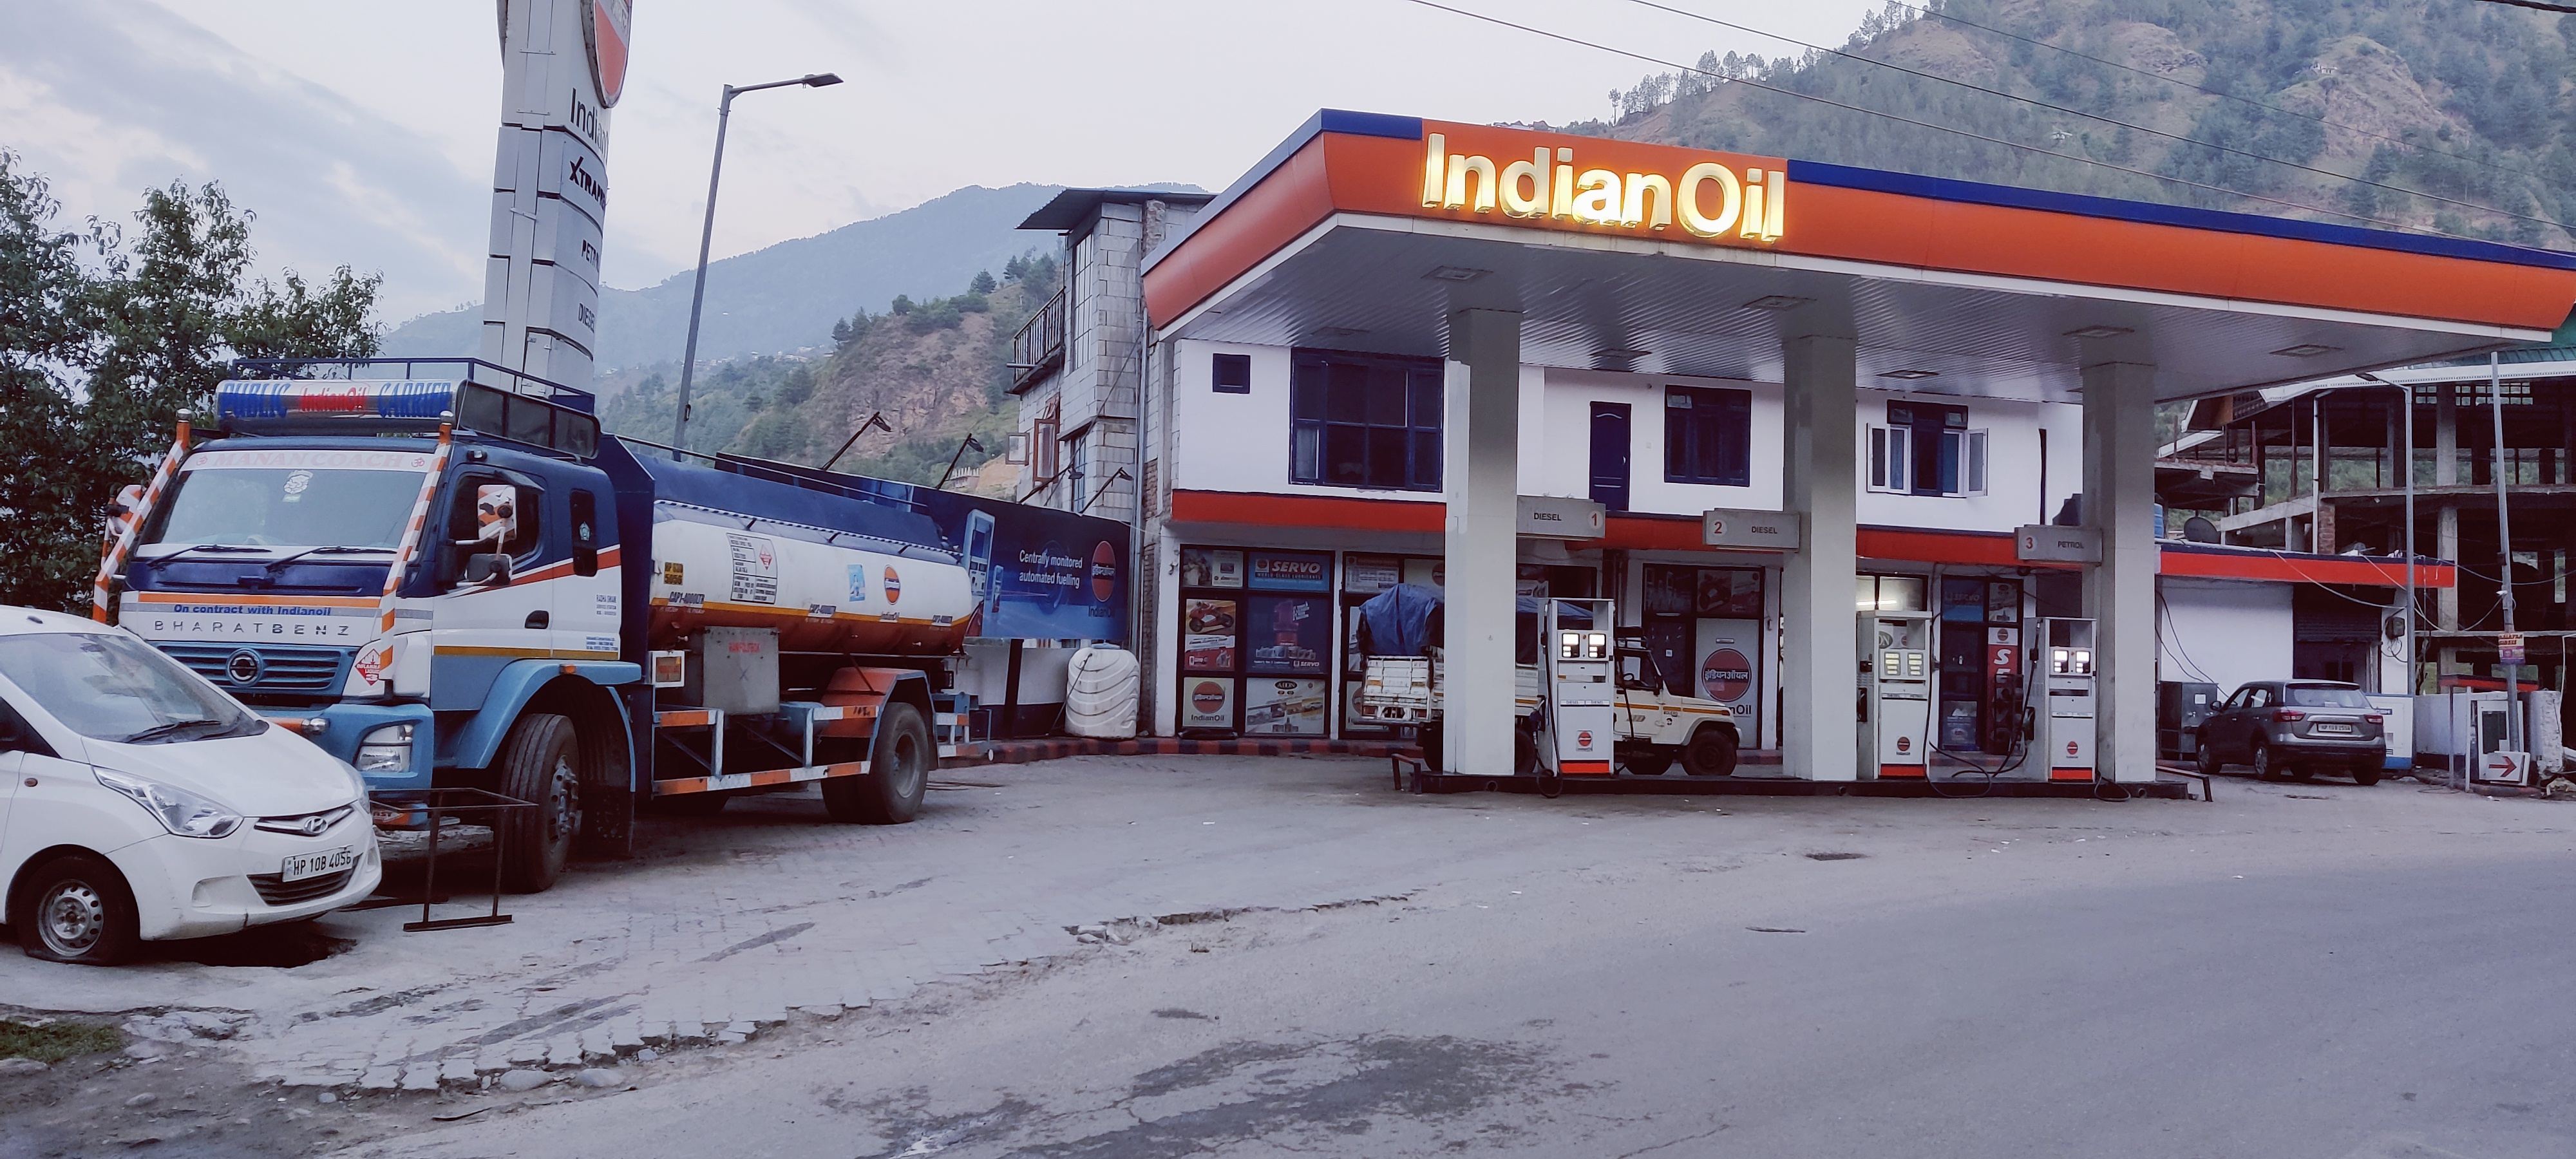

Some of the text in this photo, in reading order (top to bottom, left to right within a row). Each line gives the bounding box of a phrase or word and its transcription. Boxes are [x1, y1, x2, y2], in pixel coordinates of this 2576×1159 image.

[1422, 133, 1786, 244] IndianOil
[218, 382, 290, 418] PUBLIC
[377, 382, 452, 418] CARRIER
[213, 453, 405, 469] MANAN COACH
[1533, 513, 1597, 526] DIESEL 1
[1714, 521, 1778, 534] 2 DIESEL
[2025, 537, 2085, 549] 3 PETROL
[1019, 549, 1083, 569] Centrally monitored
[1271, 561, 1321, 574] SERVO
[1019, 572, 1080, 589] automated fuelling
[174, 604, 331, 616] On contract with Indianoil
[155, 620, 350, 636] BHARATBENZ
[294, 851, 351, 876] HP 10B 4056
